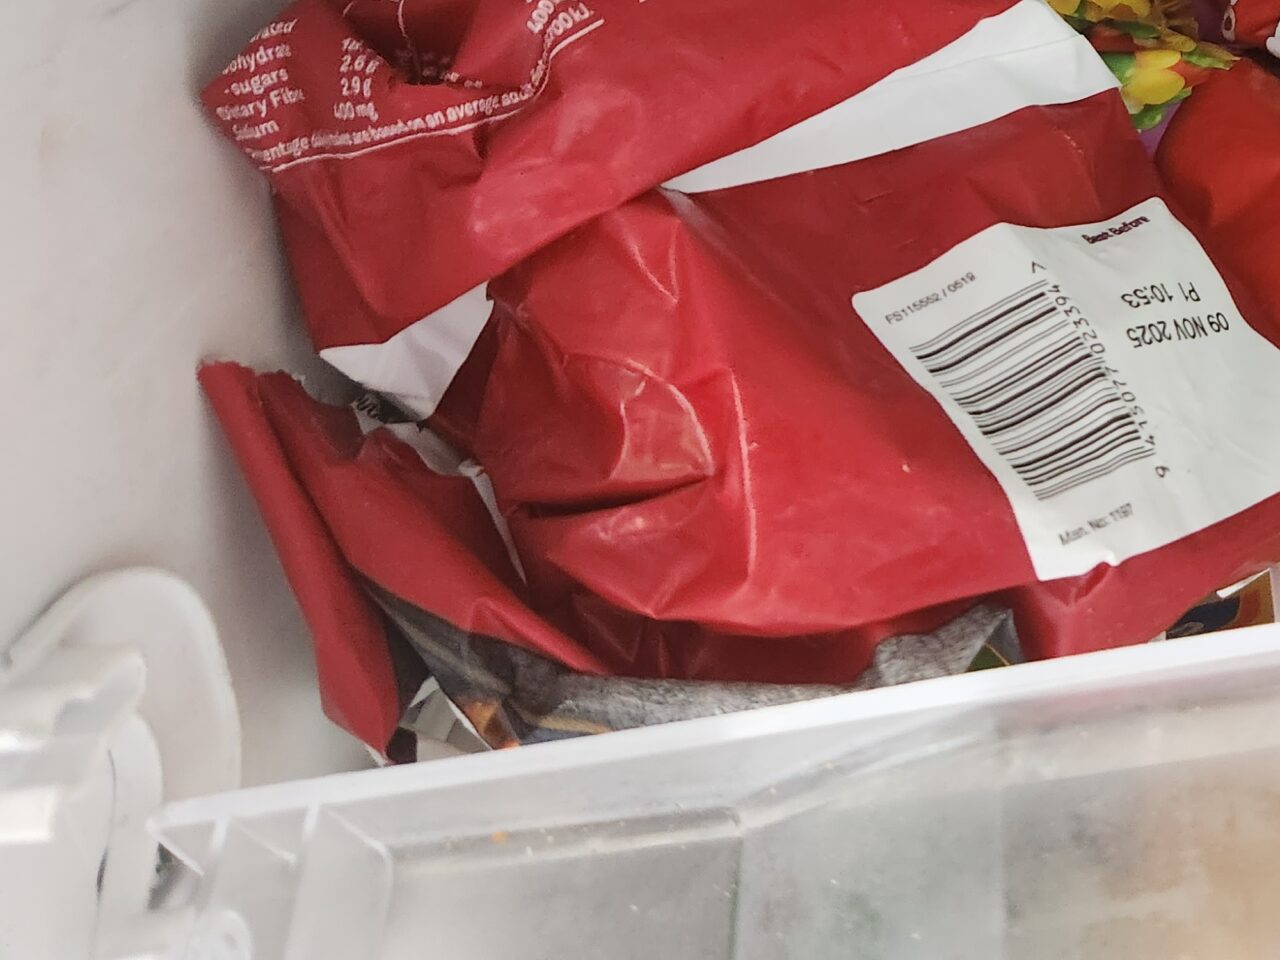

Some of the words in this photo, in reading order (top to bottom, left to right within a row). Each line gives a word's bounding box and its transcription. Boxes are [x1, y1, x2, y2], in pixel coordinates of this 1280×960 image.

[1121, 283, 1174, 309] 10:53
[1178, 282, 1201, 304] P1
[1049, 284, 1107, 354] 023394
[1176, 316, 1209, 340] NOV
[1208, 312, 1230, 334] 09
[1126, 321, 1169, 349] 2025
[1104, 365, 1157, 447] 415077
[1154, 465, 1170, 479] 9
